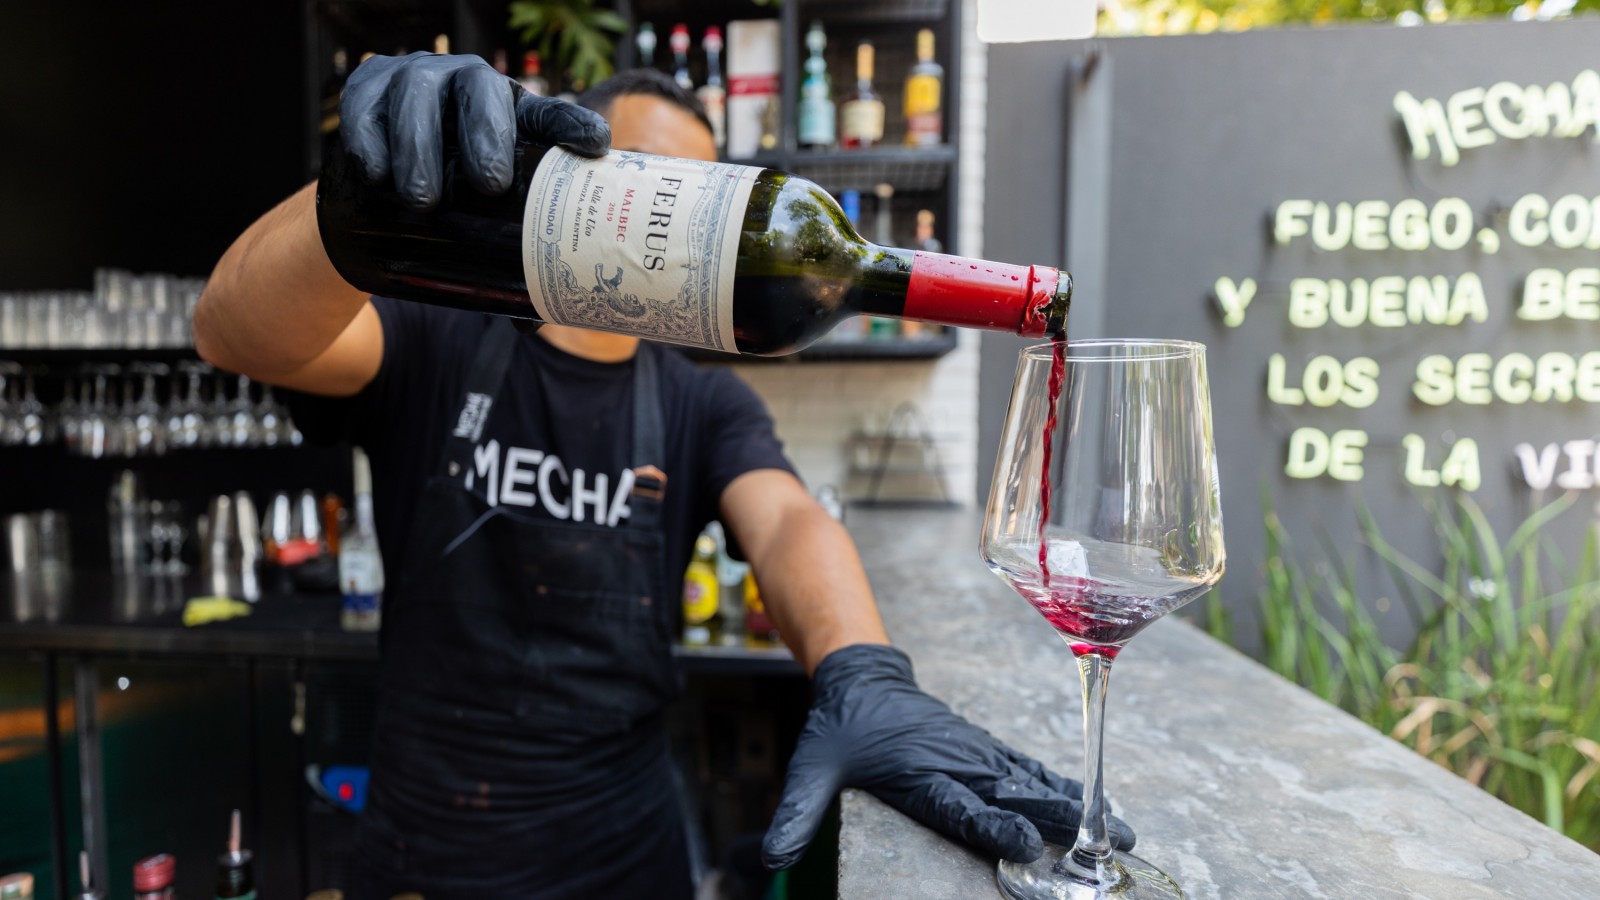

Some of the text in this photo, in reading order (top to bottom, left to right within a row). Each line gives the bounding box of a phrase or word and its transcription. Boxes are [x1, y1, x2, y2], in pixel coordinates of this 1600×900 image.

[1394, 69, 1600, 166] MECHA
[545, 177, 565, 235] HERMANDAD
[572, 206, 583, 252] ARGENTINA
[585, 185, 604, 237] Valle de Uco
[606, 201, 616, 222] 2019
[616, 188, 635, 243] MALBEC
[643, 176, 683, 271] FERUS
[1215, 267, 1600, 327] Y BUENA BE
[1267, 350, 1600, 408] LOS SECRE
[464, 439, 636, 528] MECHA
[1284, 427, 1600, 492] DE LA VI
